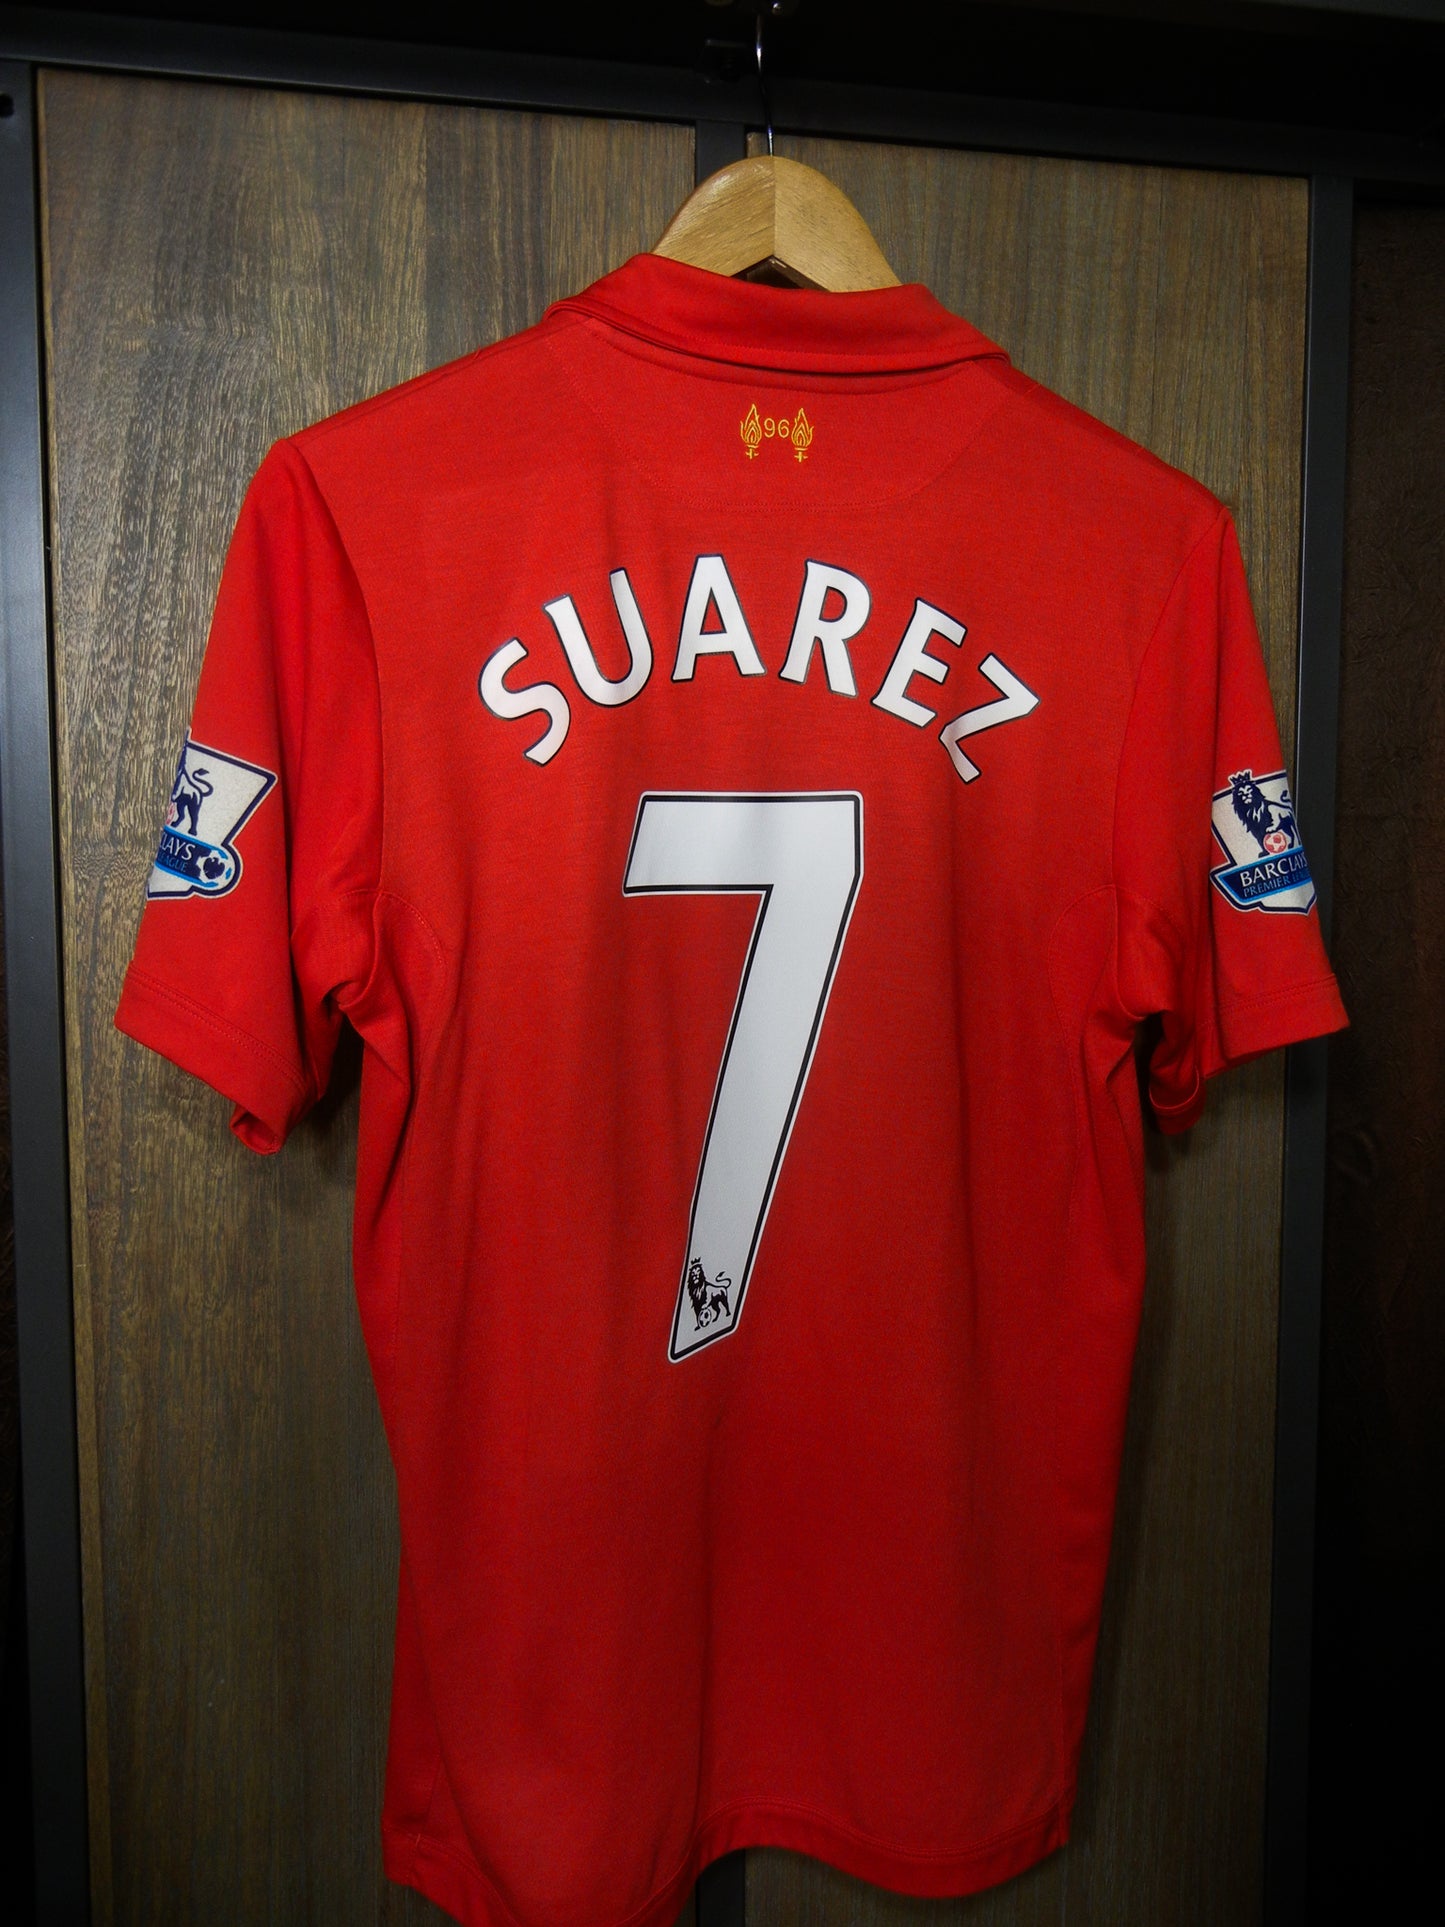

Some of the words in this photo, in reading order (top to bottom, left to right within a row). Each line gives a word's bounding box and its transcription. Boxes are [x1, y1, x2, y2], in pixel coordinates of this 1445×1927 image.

[763, 417, 790, 438] 96
[478, 553, 1040, 784] SUAREZ
[1243, 875, 1291, 897] PREMIER
[623, 790, 864, 1364] 7
